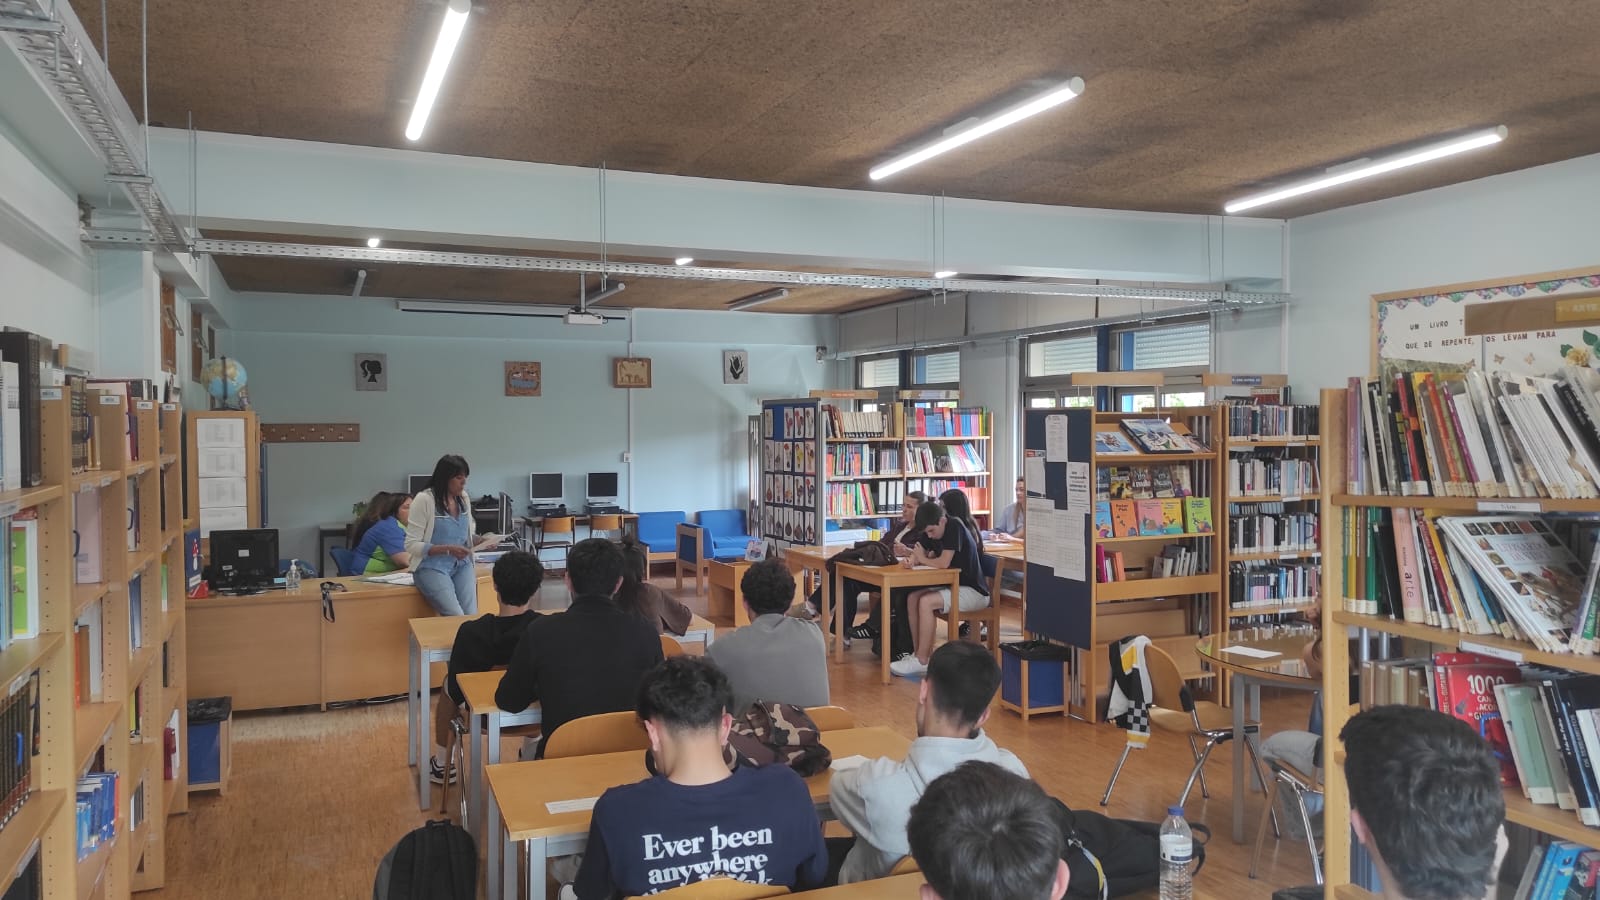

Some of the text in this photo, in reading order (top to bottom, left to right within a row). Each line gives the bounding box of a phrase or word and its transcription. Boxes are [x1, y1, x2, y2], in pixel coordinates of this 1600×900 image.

[1409, 323, 1420, 331] UM
[1429, 320, 1449, 329] LIVRO
[1405, 342, 1418, 350] QUE
[1423, 340, 1433, 348] DE
[1503, 332, 1528, 342] LEVAM
[1536, 330, 1556, 340] PARA
[1404, 572, 1415, 599] arte
[641, 825, 773, 861] Ever been
[648, 850, 769, 887] anywhere
